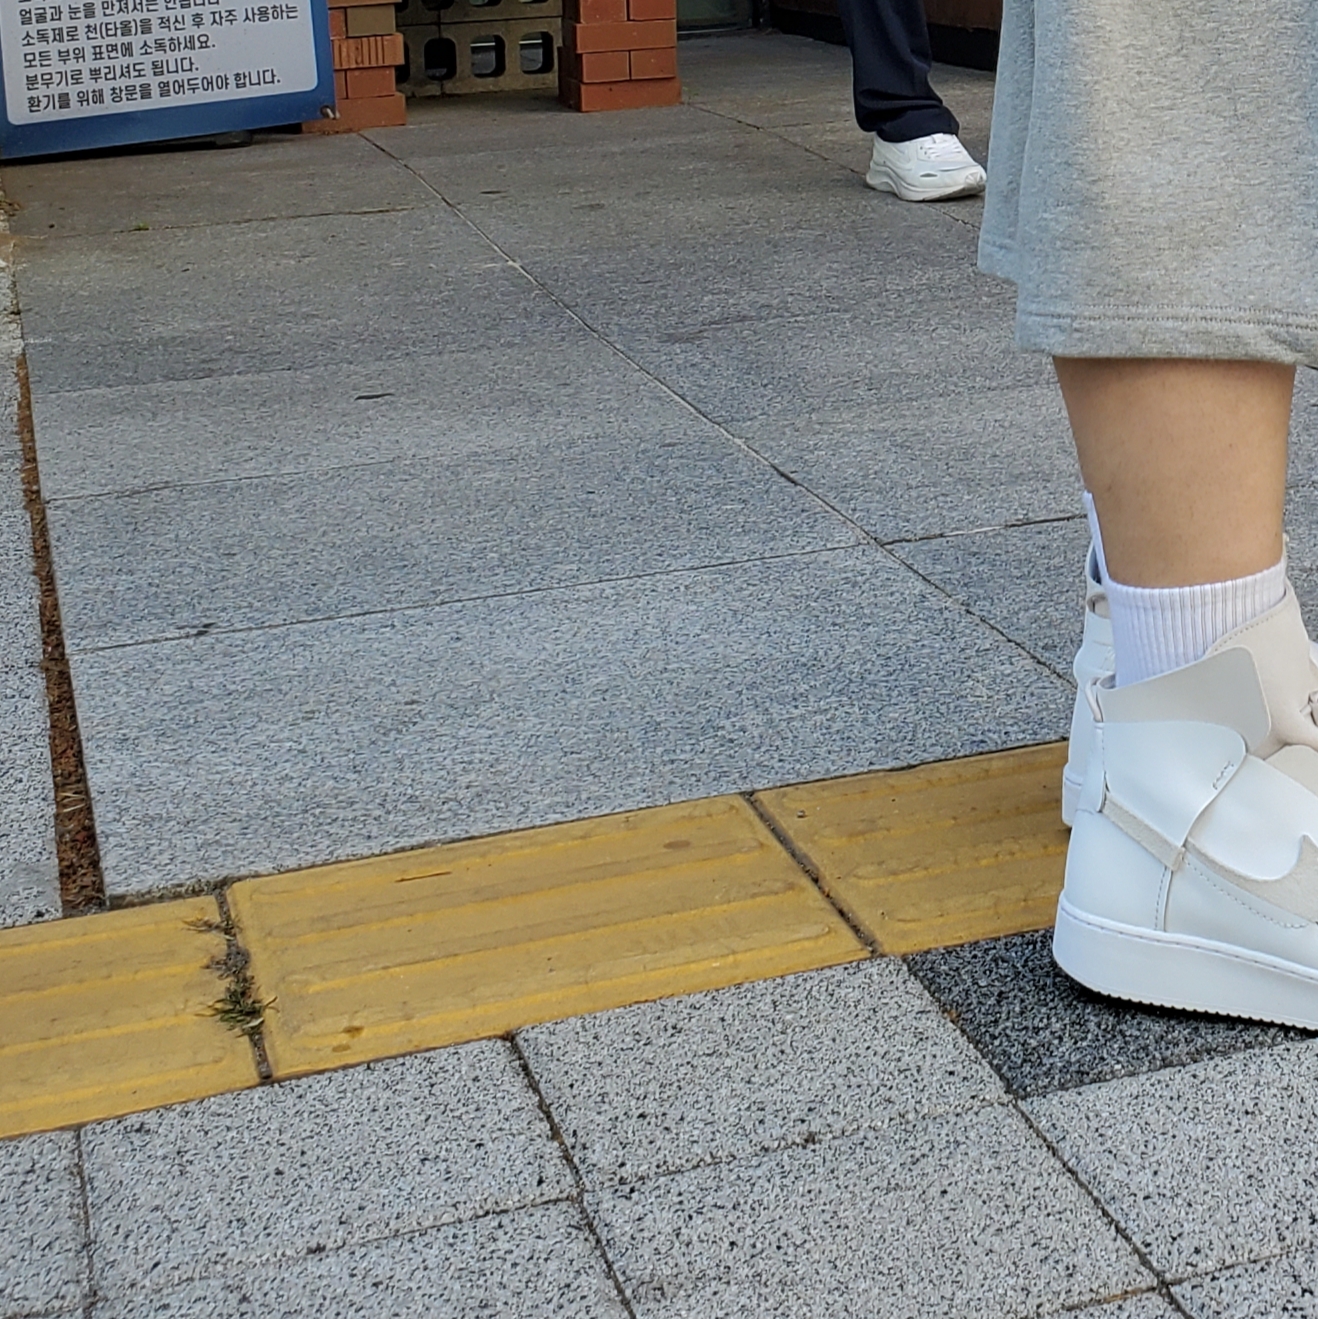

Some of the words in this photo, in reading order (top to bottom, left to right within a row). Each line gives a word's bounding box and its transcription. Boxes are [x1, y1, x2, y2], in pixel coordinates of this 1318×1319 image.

[19, 4, 63, 26] 얼굴과
[68, 1, 97, 21] 눈을
[21, 25, 79, 47] 소독제로
[84, 18, 153, 41] 천(타올)을
[157, 15, 186, 33] 적신
[191, 13, 206, 30] 후
[210, 9, 238, 27] 자주
[243, 3, 299, 24] 사용하는
[23, 51, 52, 69] 모든
[57, 47, 86, 66] 부위
[92, 40, 134, 62] 표면에
[139, 33, 216, 55] 소독하세요.
[25, 68, 83, 91] 분무기로
[89, 62, 147, 84] 뿌리셔도
[151, 56, 199, 77] 됩니다.
[27, 91, 71, 114] 환기를
[76, 88, 105, 108] 위해
[110, 82, 152, 104] 창문을
[157, 73, 229, 97] 열어두어야
[233, 67, 281, 90] 합니다.
